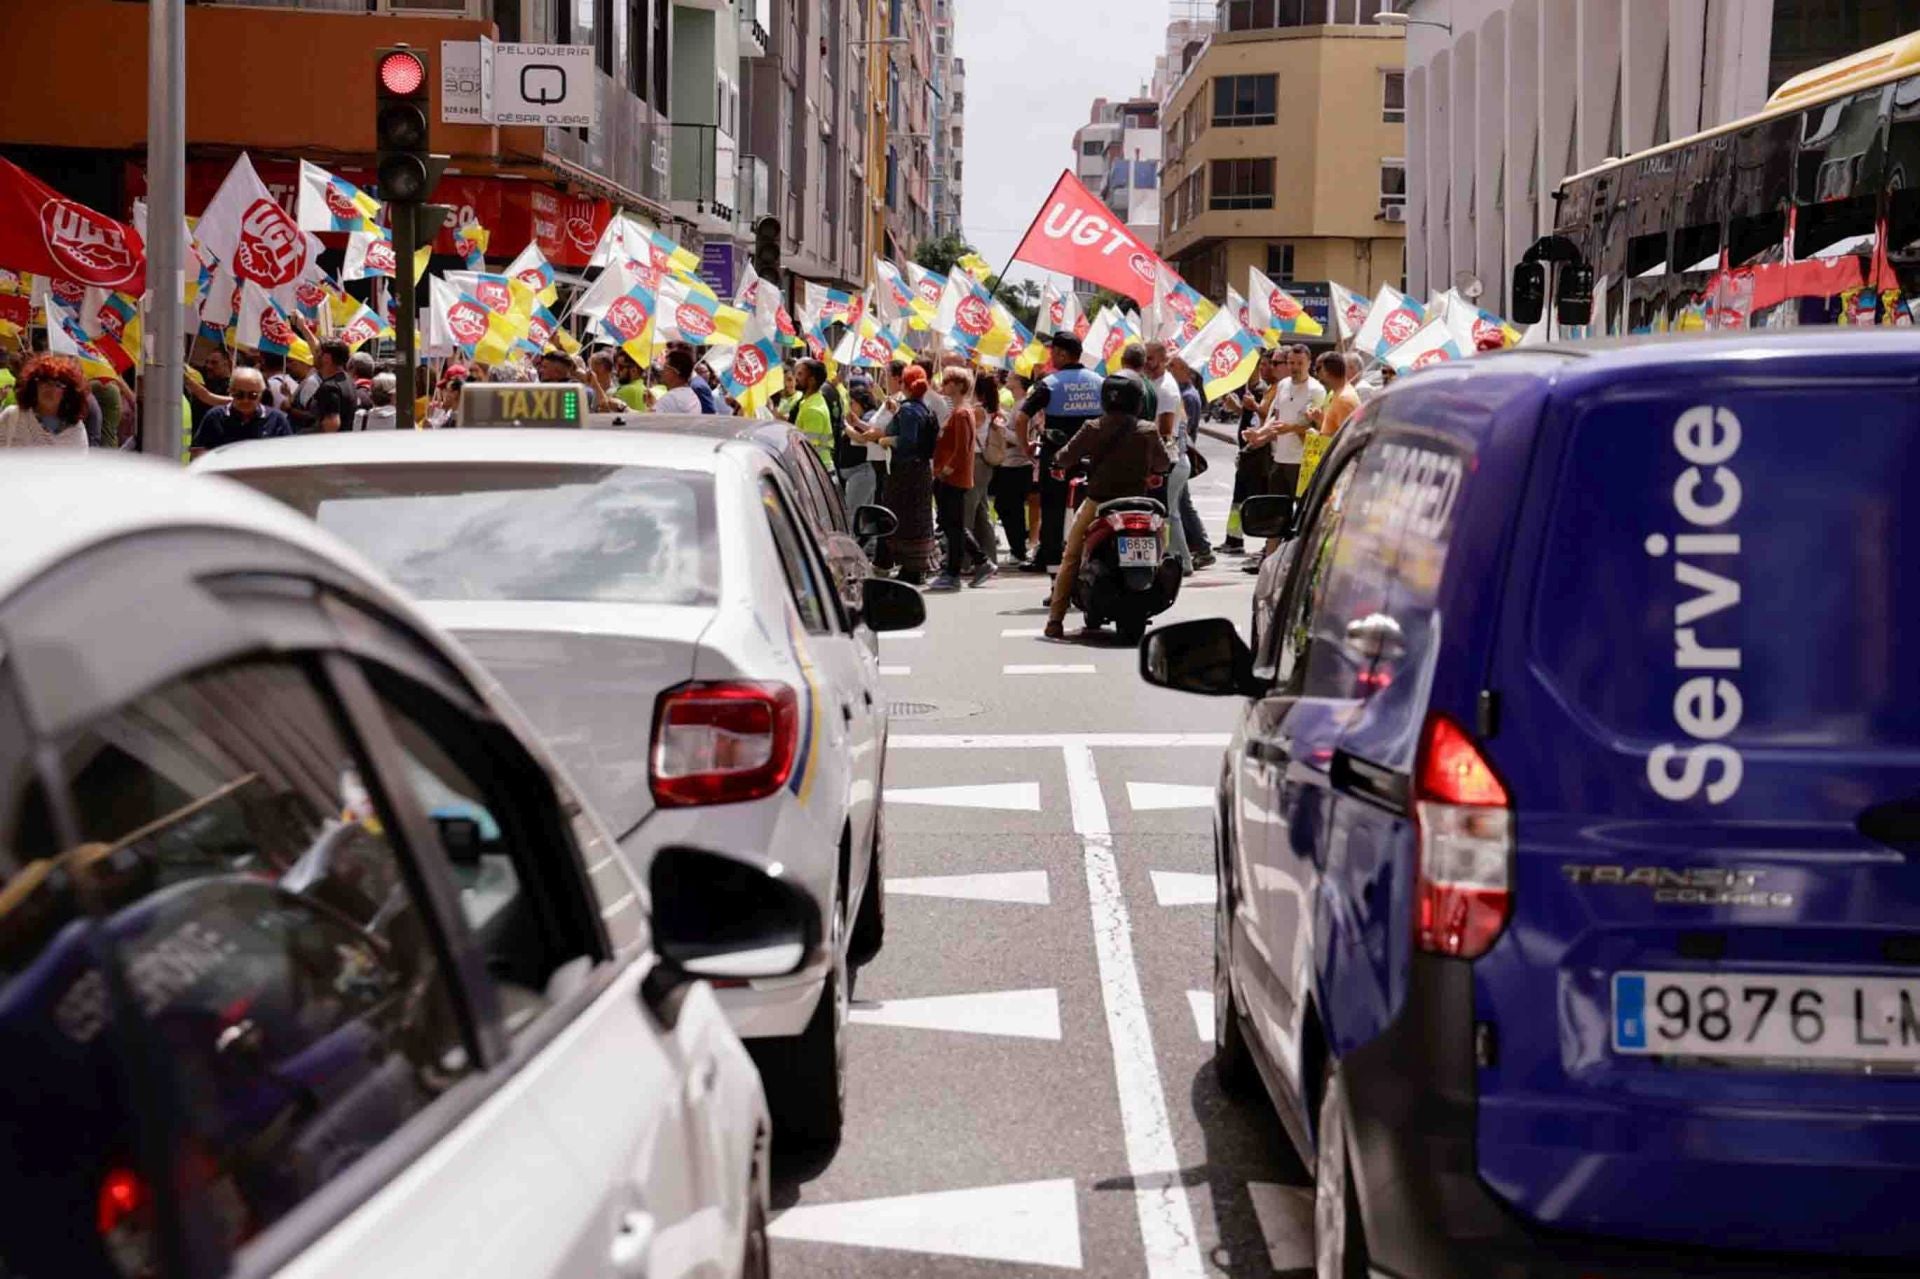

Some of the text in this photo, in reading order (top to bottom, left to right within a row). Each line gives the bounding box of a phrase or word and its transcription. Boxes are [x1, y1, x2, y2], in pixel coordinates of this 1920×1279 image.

[243, 203, 304, 266] UGT
[1043, 203, 1136, 256] UGT
[499, 390, 557, 419] TAXI
[1645, 405, 1743, 805] Service
[1655, 985, 1826, 1044] 9876
